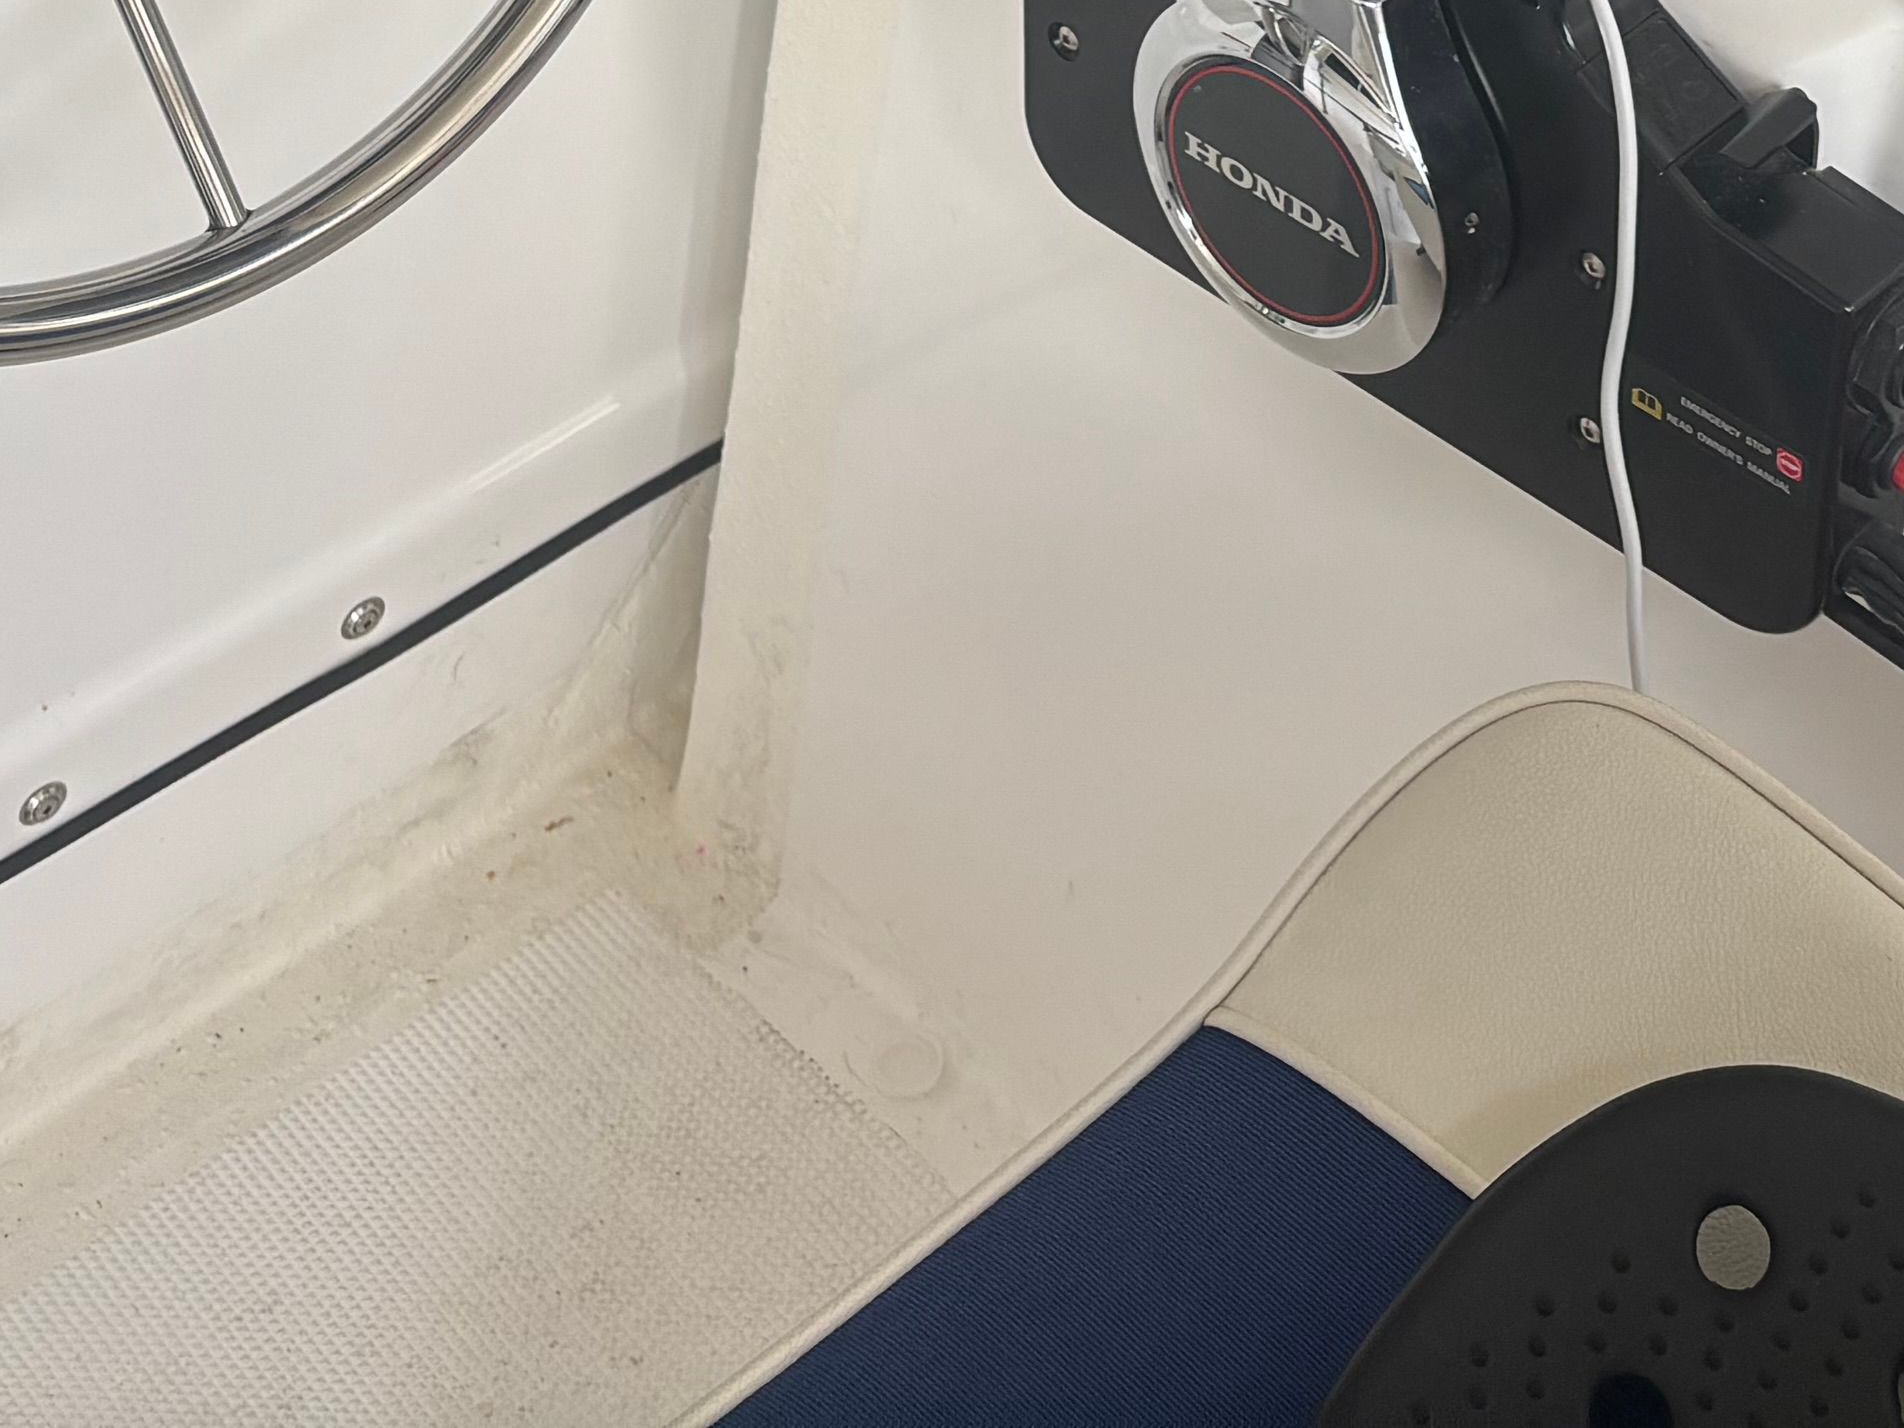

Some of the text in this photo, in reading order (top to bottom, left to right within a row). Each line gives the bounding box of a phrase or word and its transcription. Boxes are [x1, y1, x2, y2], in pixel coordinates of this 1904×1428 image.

[1184, 131, 1360, 258] HONDA
[1666, 412, 1694, 435] READ
[1747, 461, 1791, 494] MANUAL
[1746, 436, 1772, 456] STOP
